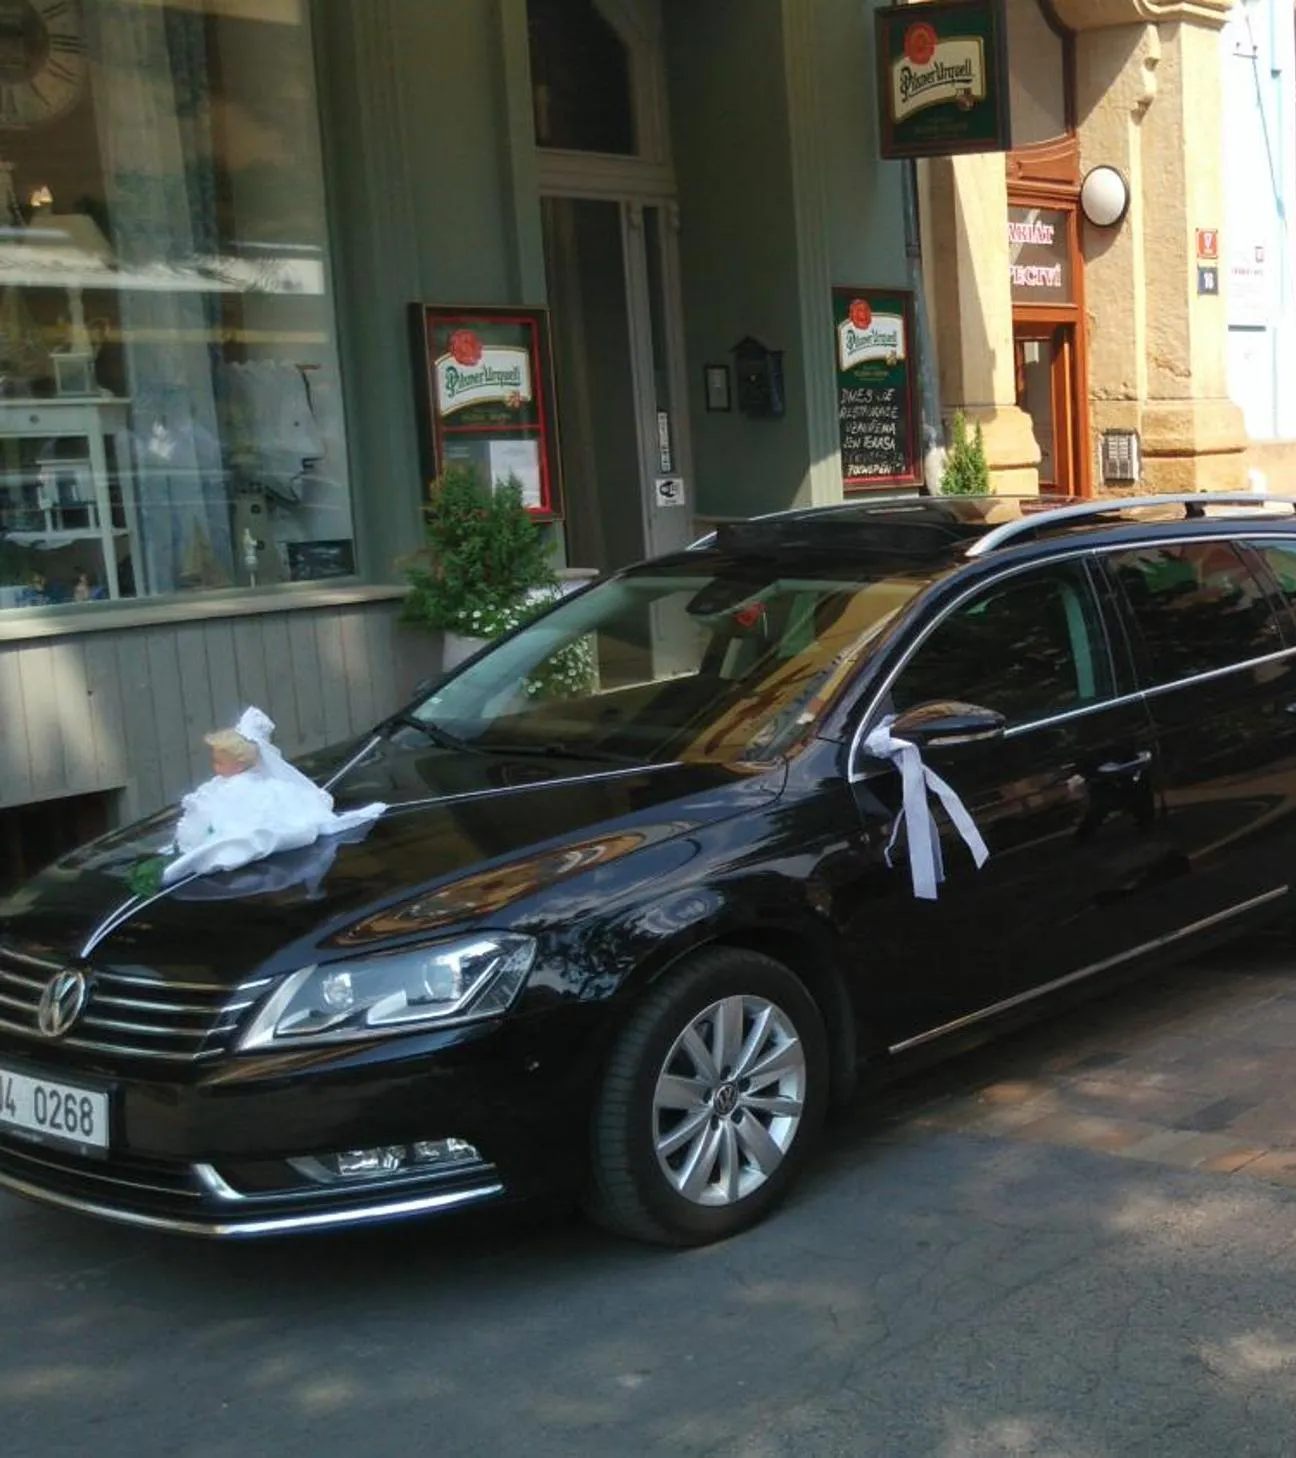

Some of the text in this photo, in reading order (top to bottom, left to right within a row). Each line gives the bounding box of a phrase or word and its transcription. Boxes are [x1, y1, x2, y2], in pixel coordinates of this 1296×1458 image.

[899, 58, 972, 103] Pilsner Urquell
[444, 363, 521, 398] Pilsner Urquell
[0, 1075, 94, 1137] 4 0268
